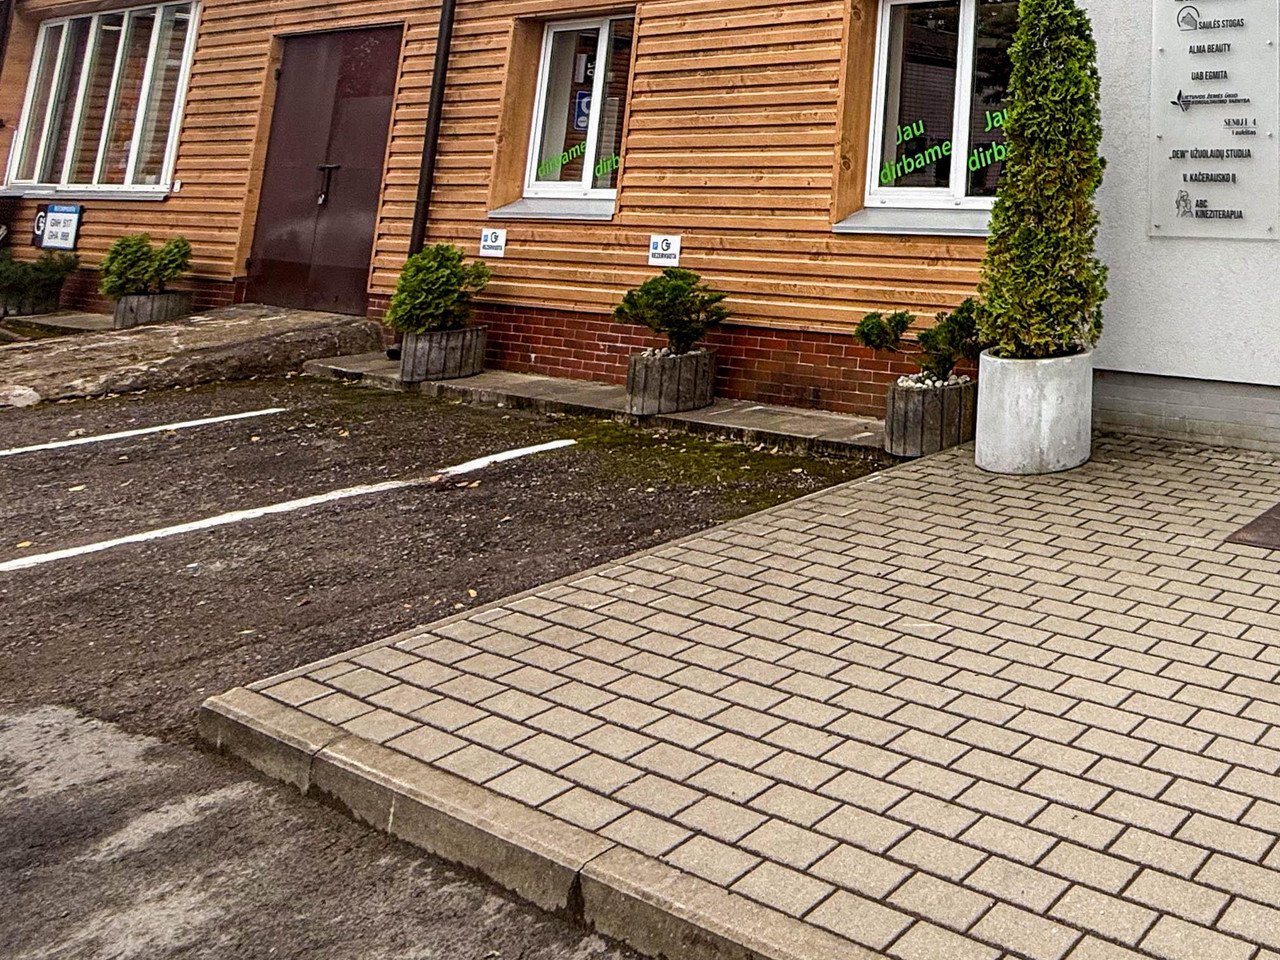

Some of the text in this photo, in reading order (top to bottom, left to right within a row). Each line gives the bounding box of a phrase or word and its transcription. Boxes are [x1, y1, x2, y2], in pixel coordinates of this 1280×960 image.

[1221, 18, 1245, 28] STOGAS
[1188, 43, 1232, 55] ALMA BEAUTY
[1191, 70, 1228, 81] UAB EGMITA
[895, 119, 925, 145] Jau
[1225, 149, 1252, 159] STUDIJA
[880, 140, 953, 184] dirbame
[1189, 171, 1231, 183] KAČERAUSKO
[1195, 199, 1208, 209] ABC
[1195, 209, 1243, 219] KINEZITERAPIJA
